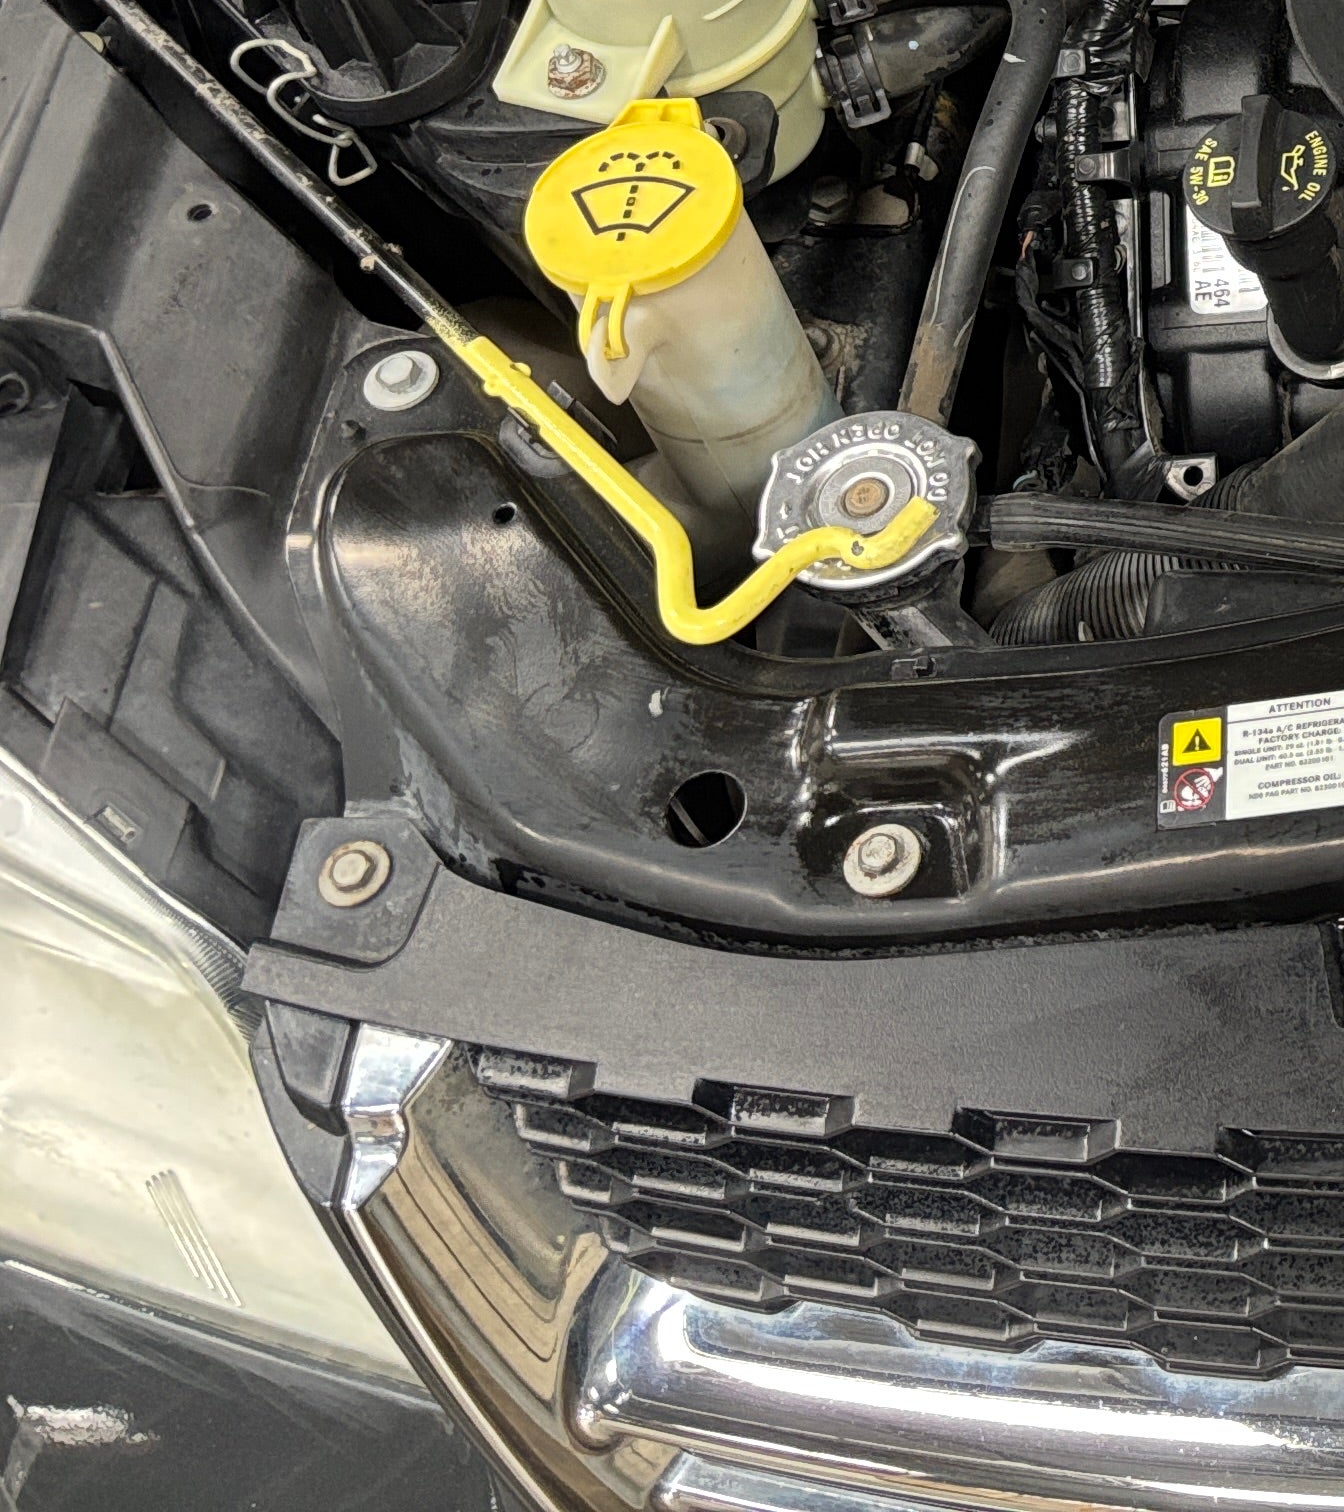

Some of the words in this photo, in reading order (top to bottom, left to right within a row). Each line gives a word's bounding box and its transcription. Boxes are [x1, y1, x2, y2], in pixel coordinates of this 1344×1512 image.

[1194, 138, 1218, 161] SAE
[1304, 130, 1328, 176] ENGINE
[1189, 166, 1209, 206] 5W-30
[1297, 182, 1320, 201] OIL
[1195, 279, 1212, 302] AE
[1213, 278, 1230, 308] 464
[1268, 697, 1330, 713] ATTENTION
[1258, 732, 1299, 744] FACTORY
[1276, 723, 1293, 733] A/C
[1258, 774, 1320, 790] COMPRESSOR
